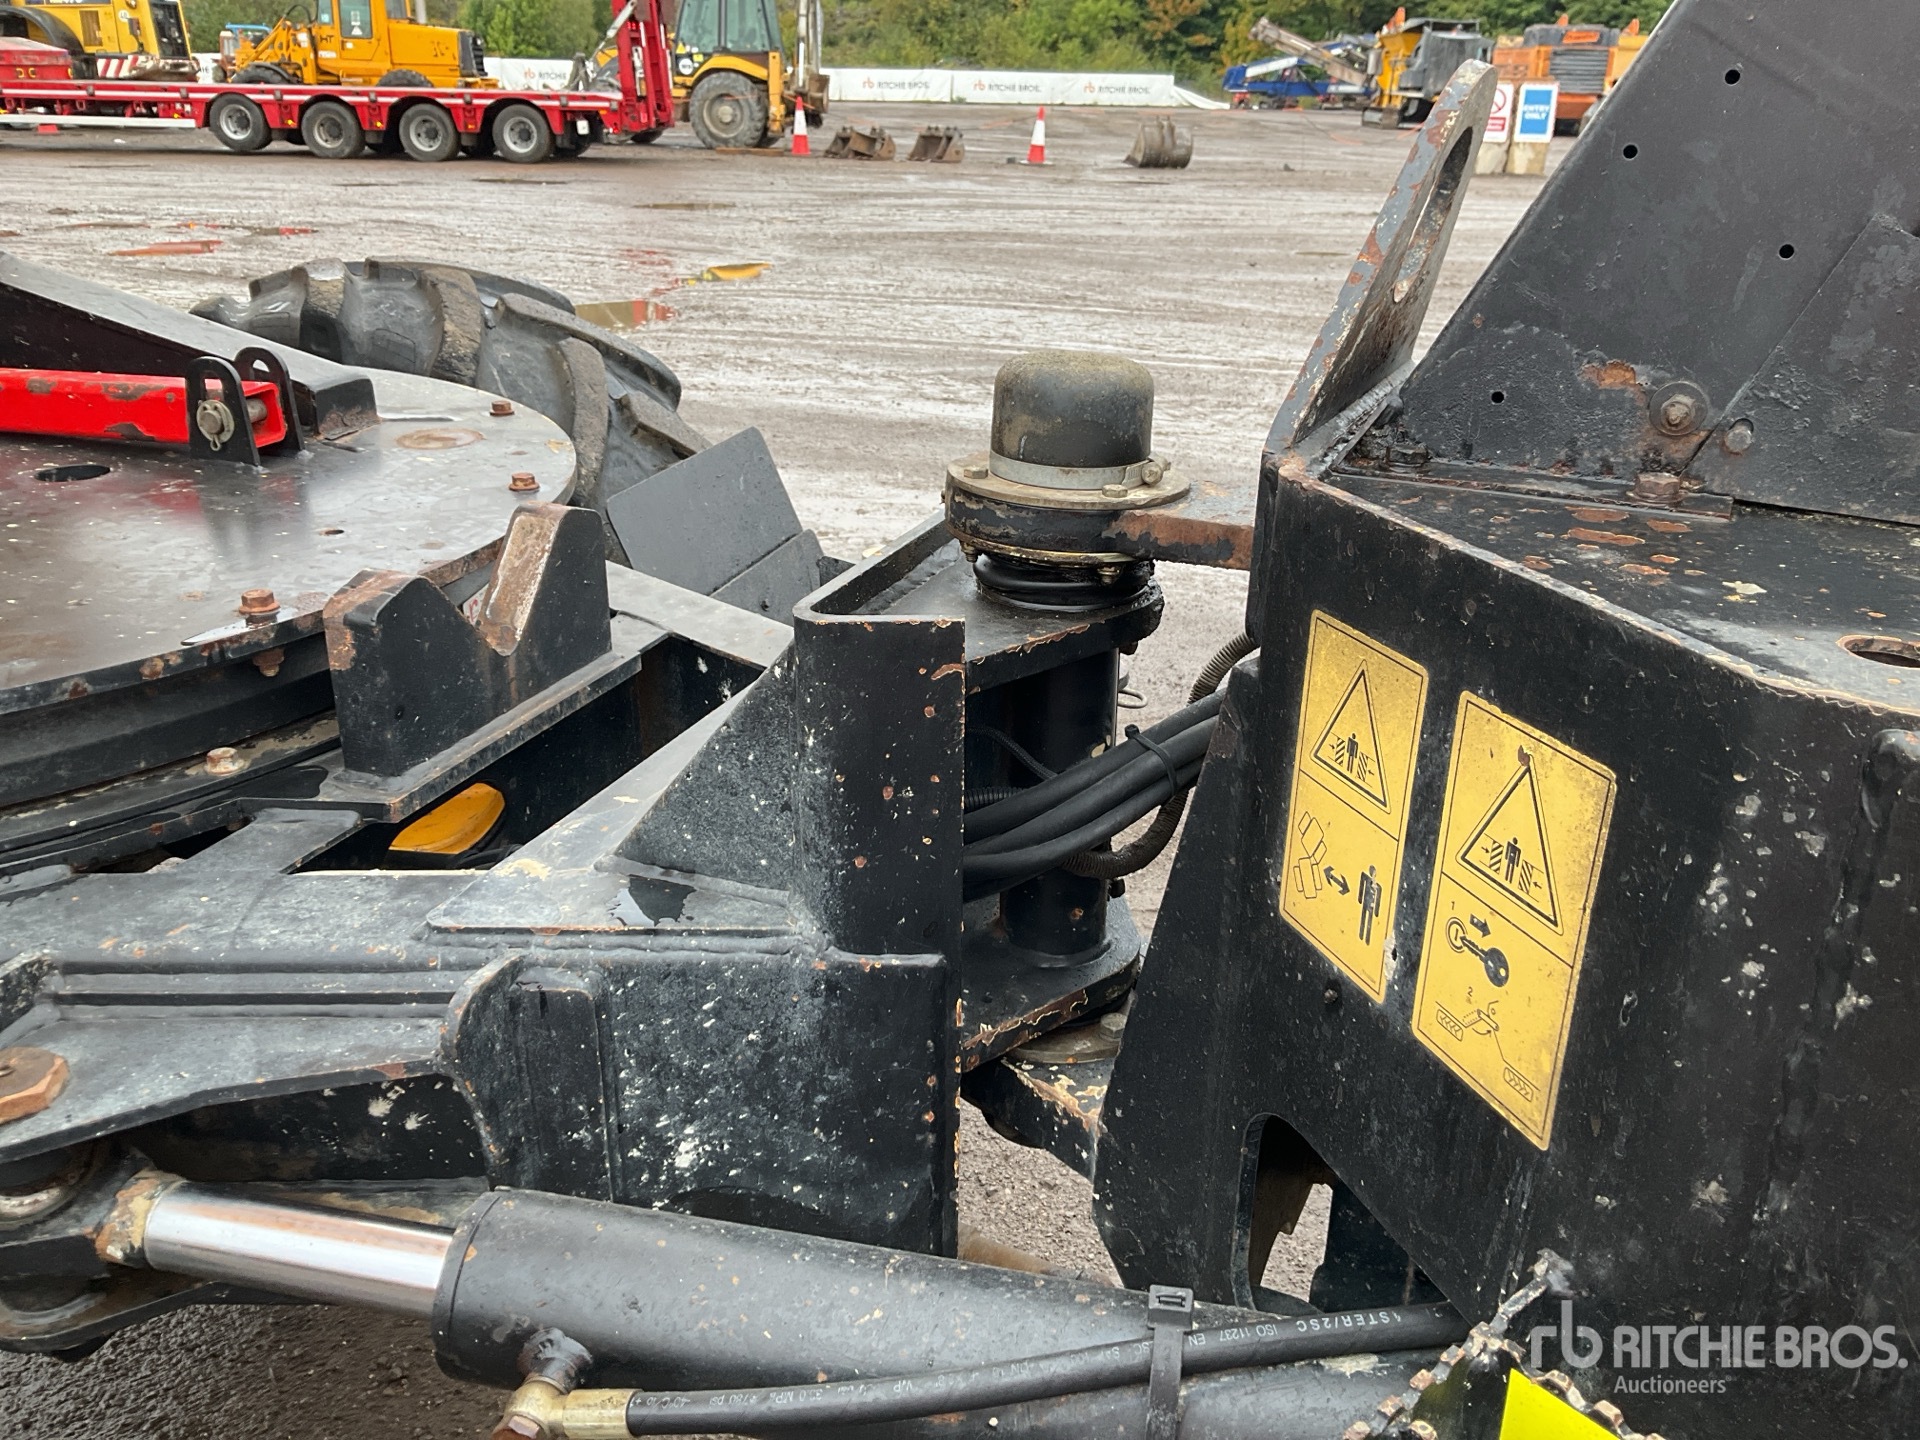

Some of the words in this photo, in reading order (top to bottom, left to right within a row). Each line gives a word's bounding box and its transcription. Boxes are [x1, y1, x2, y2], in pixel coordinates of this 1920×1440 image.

[877, 81, 906, 90] RITCHIE
[988, 83, 1016, 92] RITCHIE
[1097, 85, 1125, 95] RITCHIE
[1467, 986, 1473, 997] 2
[1219, 1327, 1250, 1341] 11237
[1256, 1324, 1278, 1337] ISO
[1188, 1333, 1206, 1346] EN
